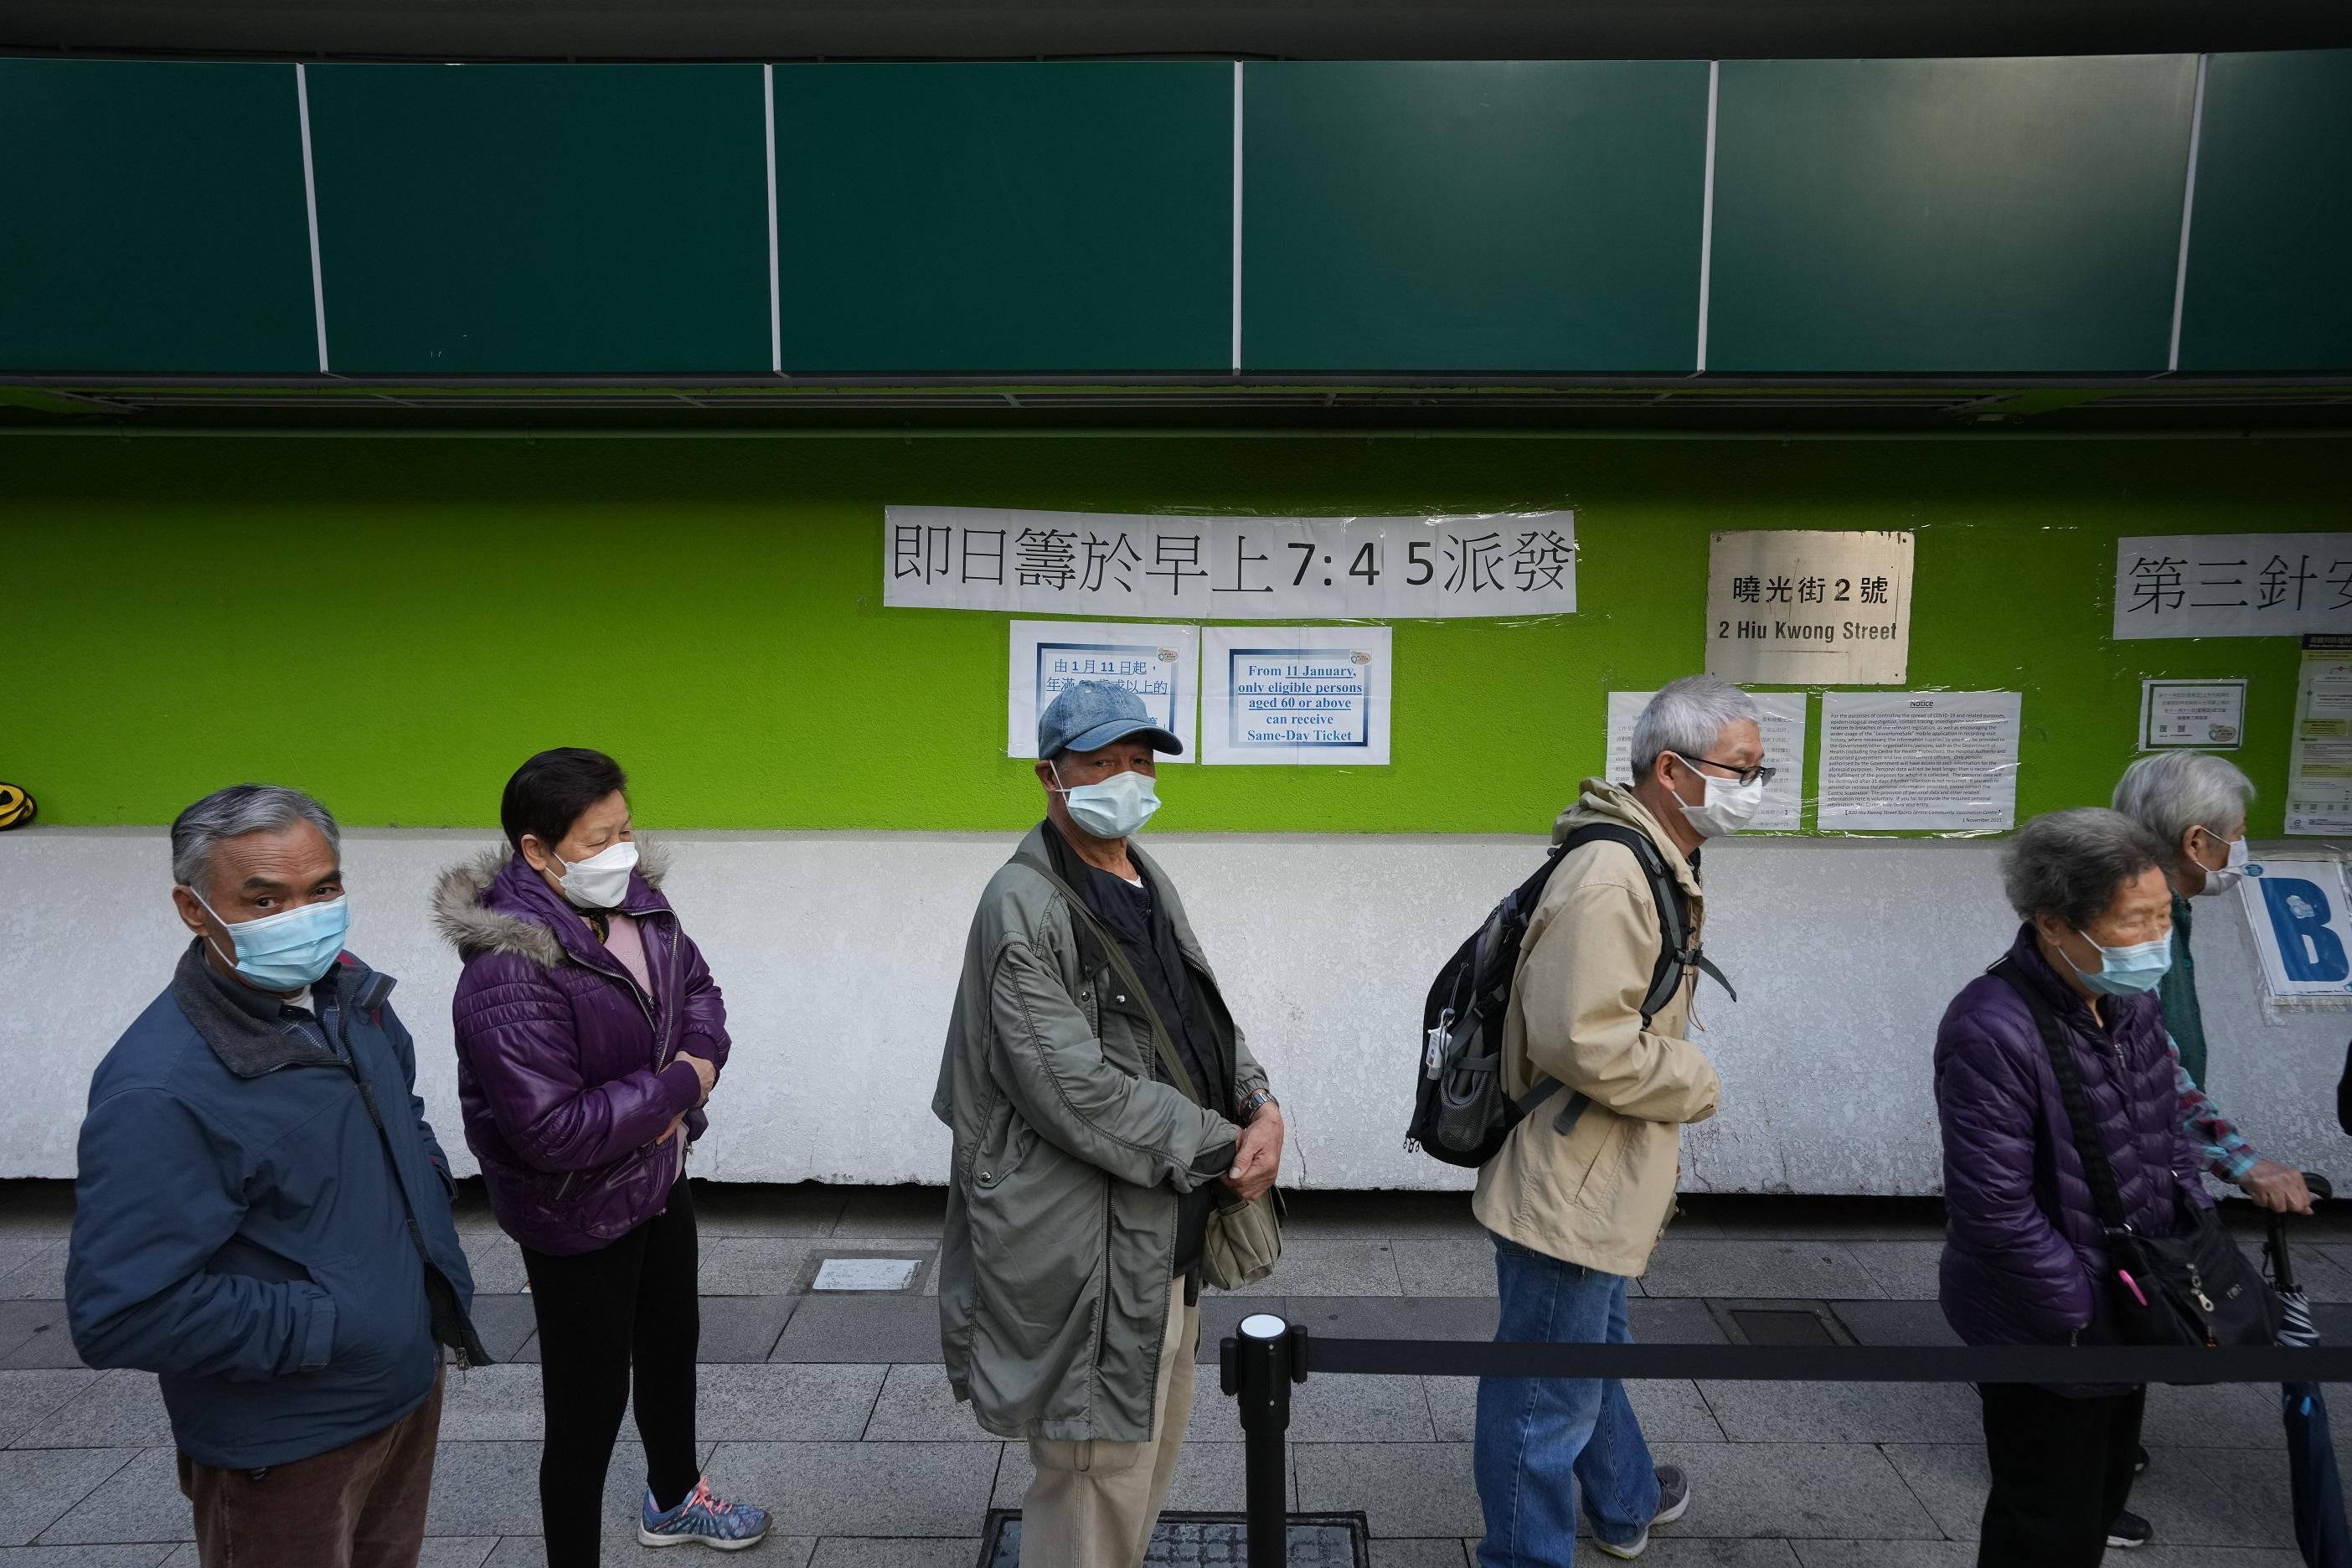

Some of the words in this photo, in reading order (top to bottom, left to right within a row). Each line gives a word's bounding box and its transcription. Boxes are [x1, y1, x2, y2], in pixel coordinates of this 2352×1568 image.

[1732, 575, 1889, 605] 曉光街2號
[1719, 622, 1729, 639] 2
[1737, 621, 1767, 639] Hiu
[1775, 621, 1834, 643] Kwong
[1843, 622, 1897, 640] Street
[1249, 666, 1282, 676] From
[1286, 666, 1297, 676] 11
[1302, 666, 1356, 678] January,
[1238, 682, 1264, 694] only
[1268, 682, 1312, 694] eligible
[1316, 684, 1362, 694] persons
[1249, 698, 1277, 709] aged
[1281, 698, 1295, 708] 60
[1316, 698, 1351, 708] above
[1266, 716, 1287, 725] can
[1292, 714, 1333, 725] receive
[1247, 730, 1309, 743] Same-Day
[1313, 730, 1352, 741] Ticket
[2258, 878, 2349, 982] B
